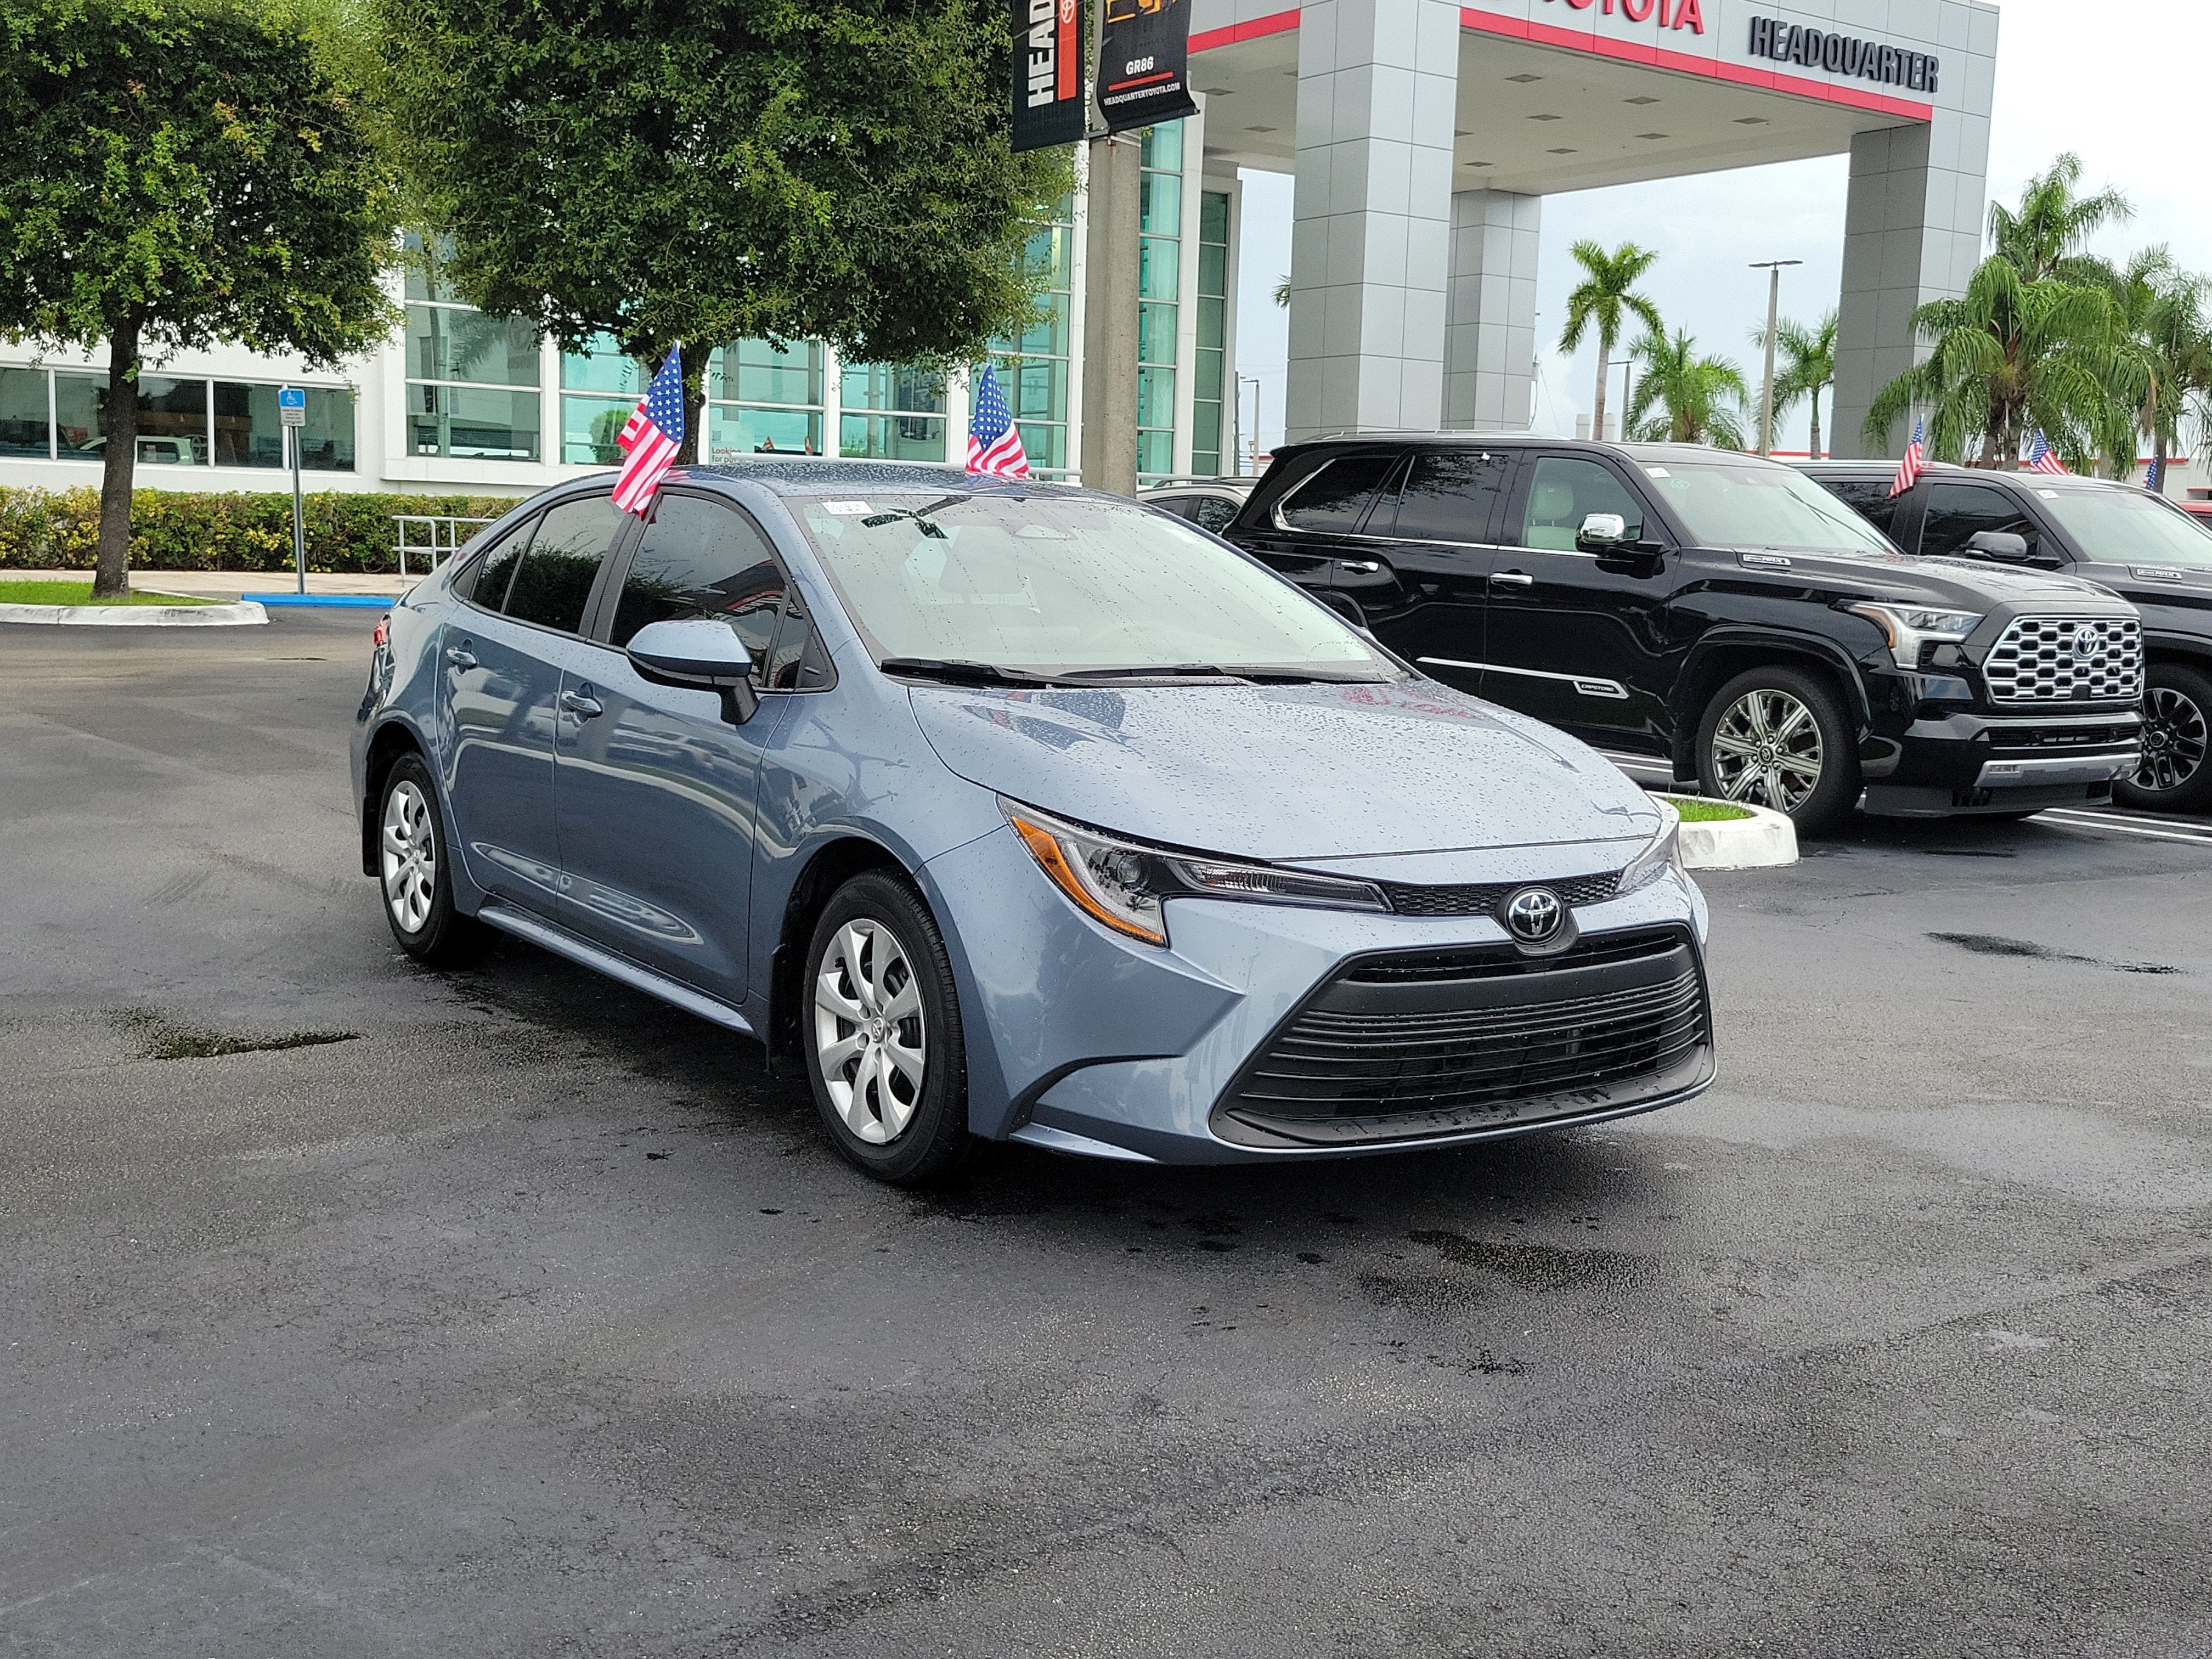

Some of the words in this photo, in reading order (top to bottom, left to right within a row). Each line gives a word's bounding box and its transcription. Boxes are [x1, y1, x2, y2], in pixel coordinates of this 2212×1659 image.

[1028, 0, 1054, 108] HEAD
[1126, 57, 1154, 75] GR86
[1749, 16, 1939, 93] HEADQUARTER
[1103, 82, 1181, 106] HEADQUARTERTOYOTA.COM
